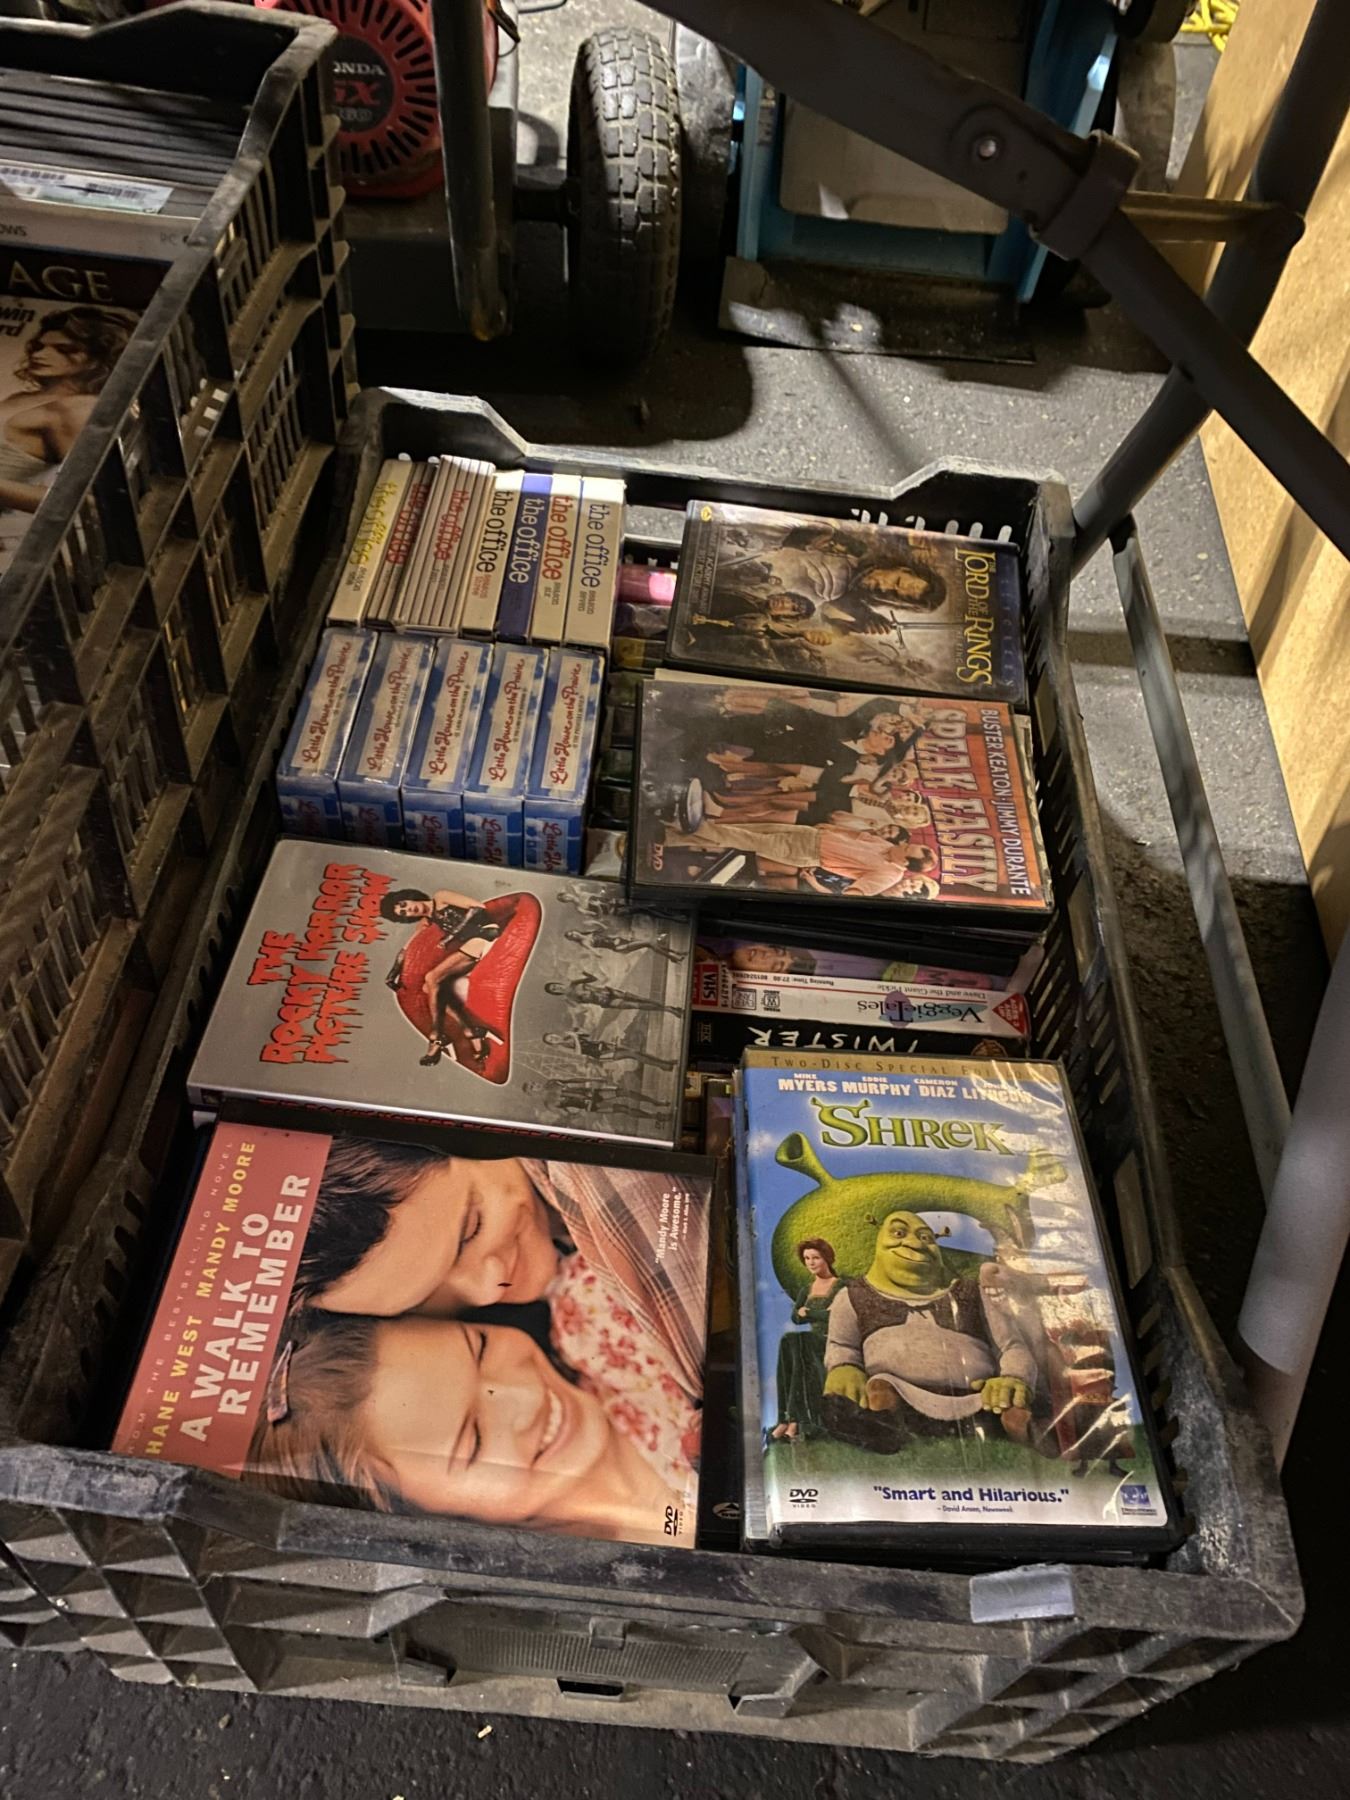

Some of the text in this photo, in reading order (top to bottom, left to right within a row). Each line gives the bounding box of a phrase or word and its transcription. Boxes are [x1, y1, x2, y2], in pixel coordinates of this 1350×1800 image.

[332, 61, 386, 76] NDA
[490, 490, 513, 516] the
[476, 518, 509, 573] office
[508, 497, 545, 583] the office
[541, 495, 573, 581] the office
[580, 503, 610, 588] the office
[955, 547, 995, 600] LORD
[967, 599, 979, 617] THE
[978, 601, 989, 616] OF
[956, 615, 995, 686] RINGS
[310, 701, 332, 738] House
[374, 706, 396, 742] House
[435, 710, 456, 746] House
[494, 717, 513, 752] House
[302, 733, 321, 764] Little
[366, 738, 386, 772] Little
[554, 723, 572, 756] House
[914, 708, 979, 791] SPEAK
[429, 745, 448, 776] Little
[488, 751, 507, 782] Little
[550, 756, 568, 785] Little
[980, 708, 1031, 896] BUSTER KEATON JIMMY DURANTE
[652, 845, 664, 871] DVD
[927, 795, 999, 893] EASILY
[247, 930, 300, 986] THE
[259, 863, 364, 1064] ROCKY HORROR
[303, 867, 398, 1063] PICTURE SHOW
[703, 972, 717, 999] VHS
[857, 999, 985, 1024] VeggieTales
[778, 1078, 838, 1093] MYERS
[842, 1081, 911, 1096] MURPHY
[913, 1078, 958, 1086] CAMERON
[919, 1085, 956, 1099] DIAZ
[210, 1142, 233, 1196] NOVEL
[659, 1193, 670, 1224] Moore
[145, 1142, 256, 1455] HANE WEST MANDY MOORE
[217, 1174, 311, 1415] REMEMBER
[179, 1213, 270, 1442] A WALK TO
[789, 1488, 819, 1498] DVD
[873, 1486, 1070, 1503] "Smart and Hilarious."
[663, 1505, 674, 1536] DVD
